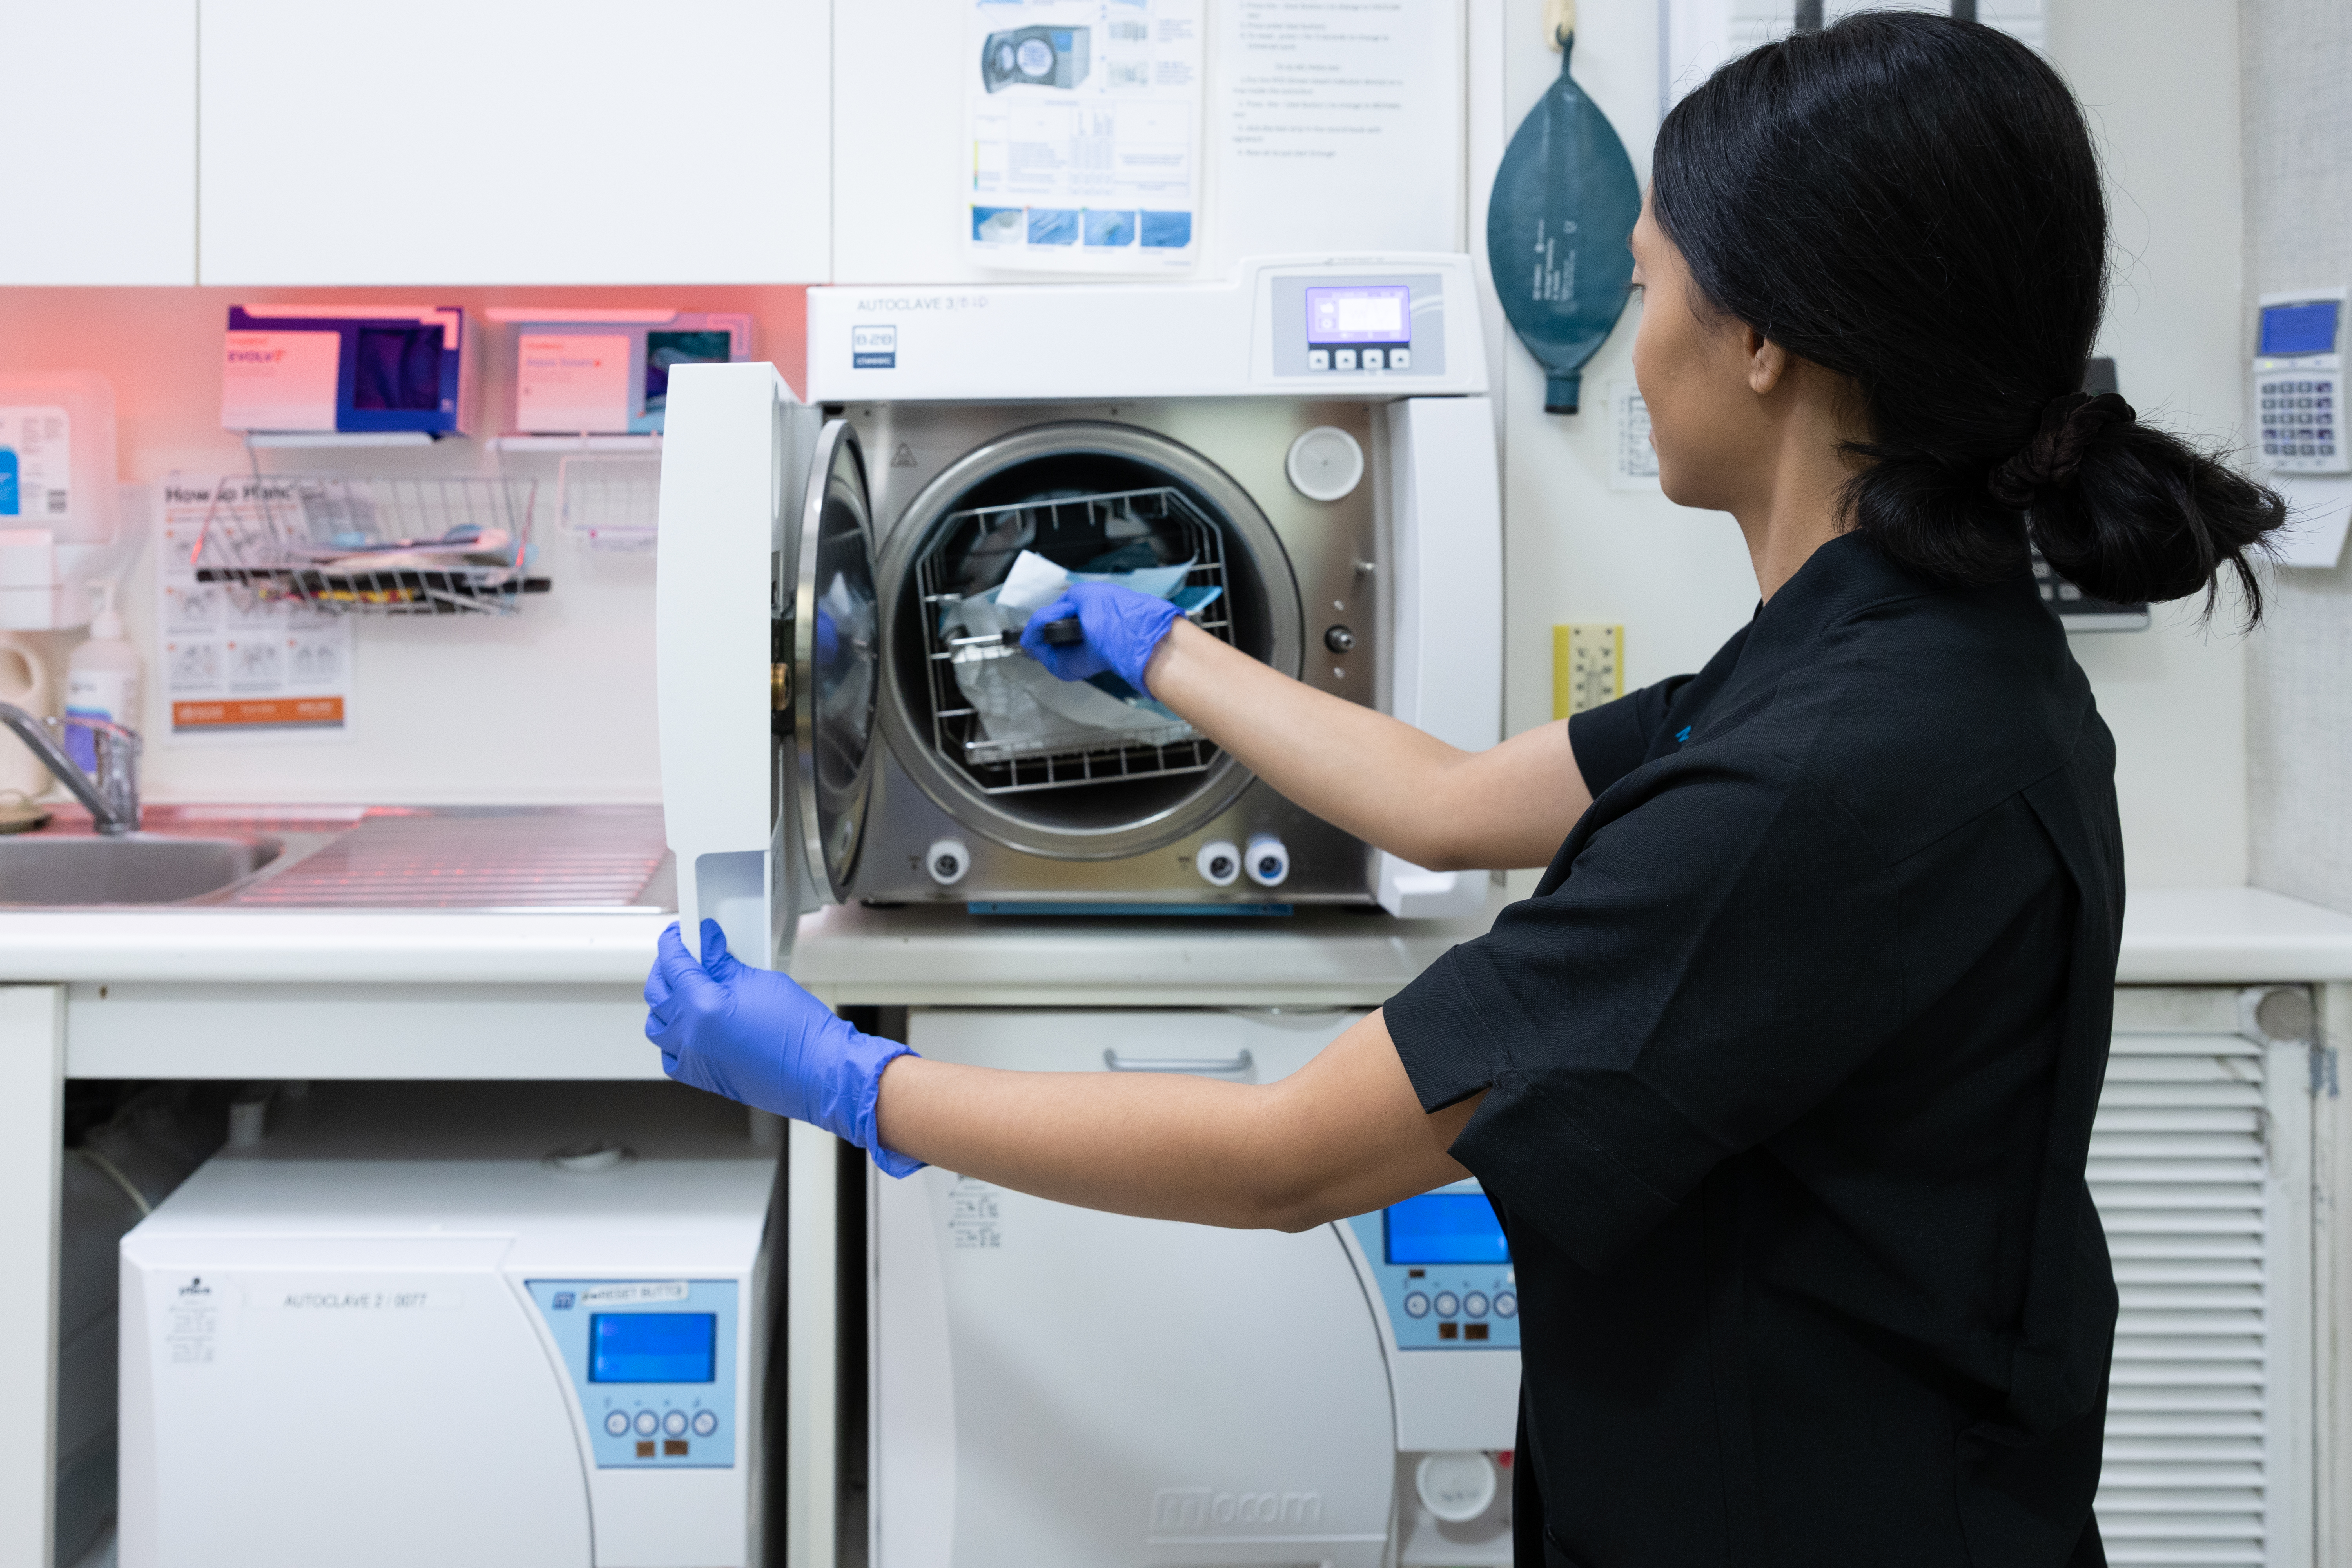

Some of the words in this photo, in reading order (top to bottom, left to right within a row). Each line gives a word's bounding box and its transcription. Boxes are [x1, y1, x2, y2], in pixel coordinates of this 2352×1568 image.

[857, 297, 942, 312] AUTOCLAVE
[165, 485, 212, 503] How
[283, 1292, 371, 1309] AUTOCLAVE
